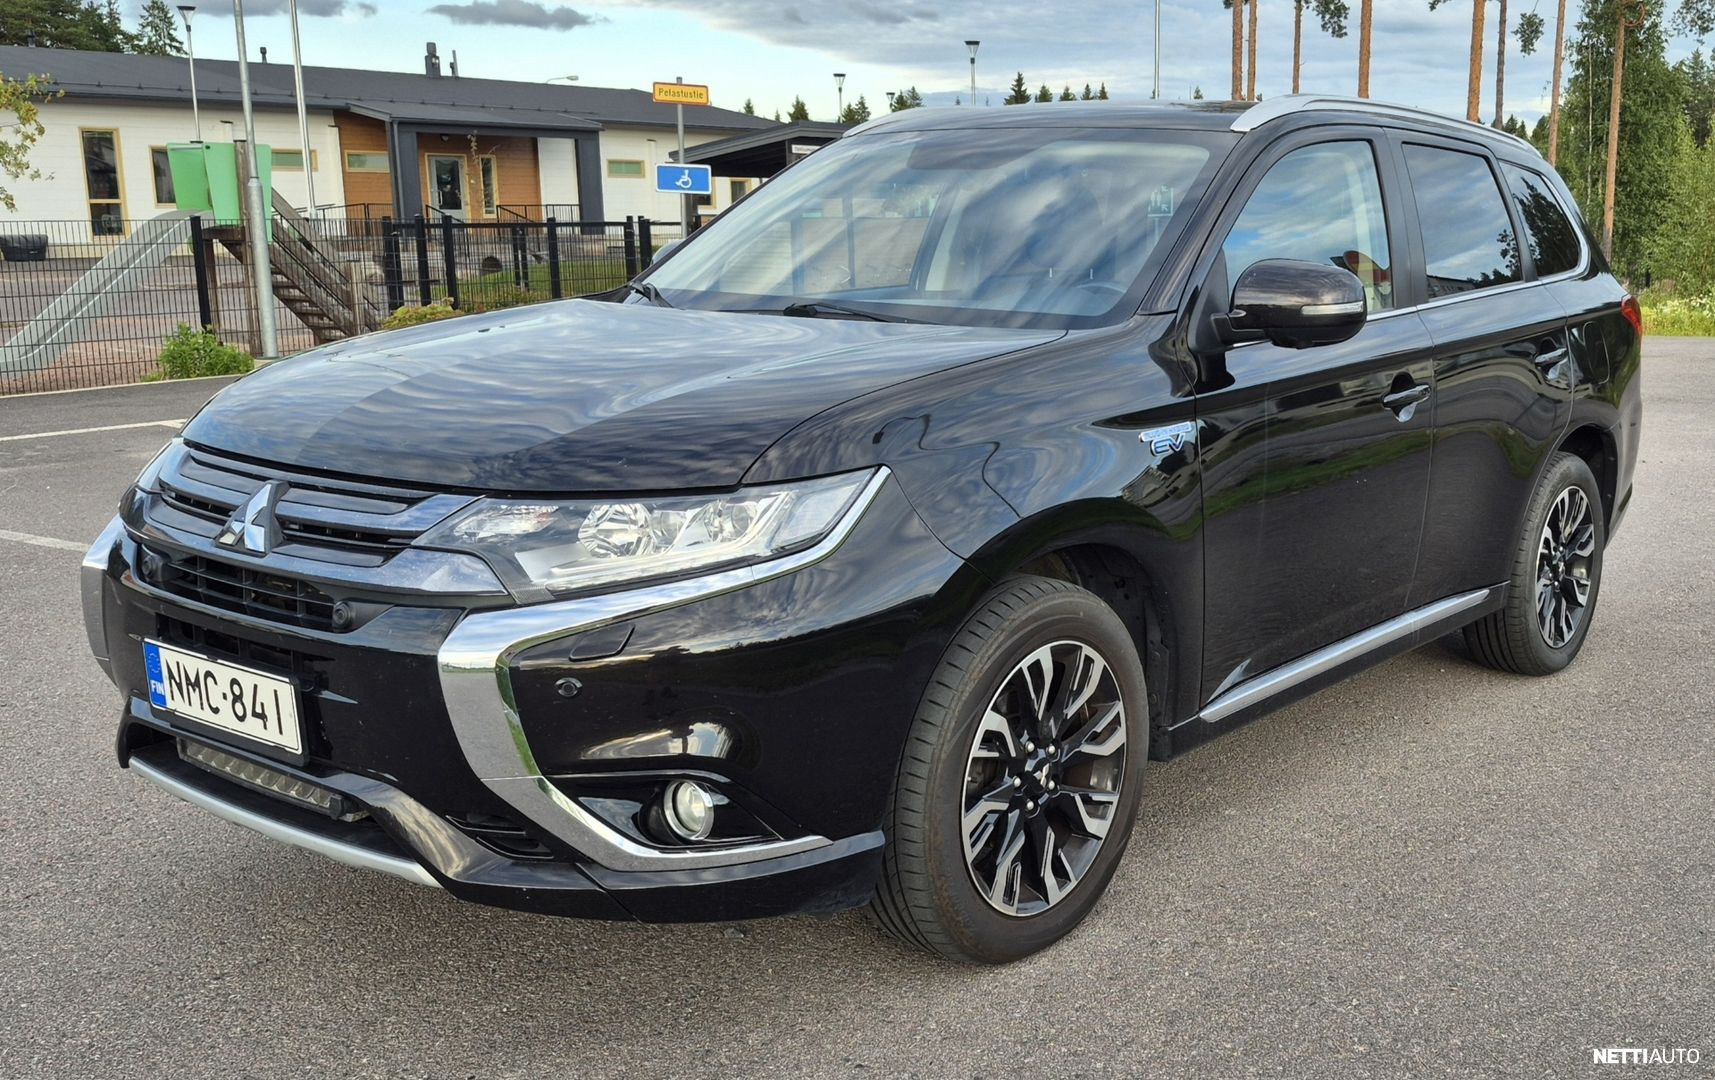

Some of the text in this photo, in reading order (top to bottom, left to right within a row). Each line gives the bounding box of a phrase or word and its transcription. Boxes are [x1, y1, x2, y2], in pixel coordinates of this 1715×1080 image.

[658, 87, 704, 100] Pelastustie
[1151, 432, 1186, 456] EV
[151, 680, 165, 696] FIN
[165, 658, 284, 736] NMC-841
